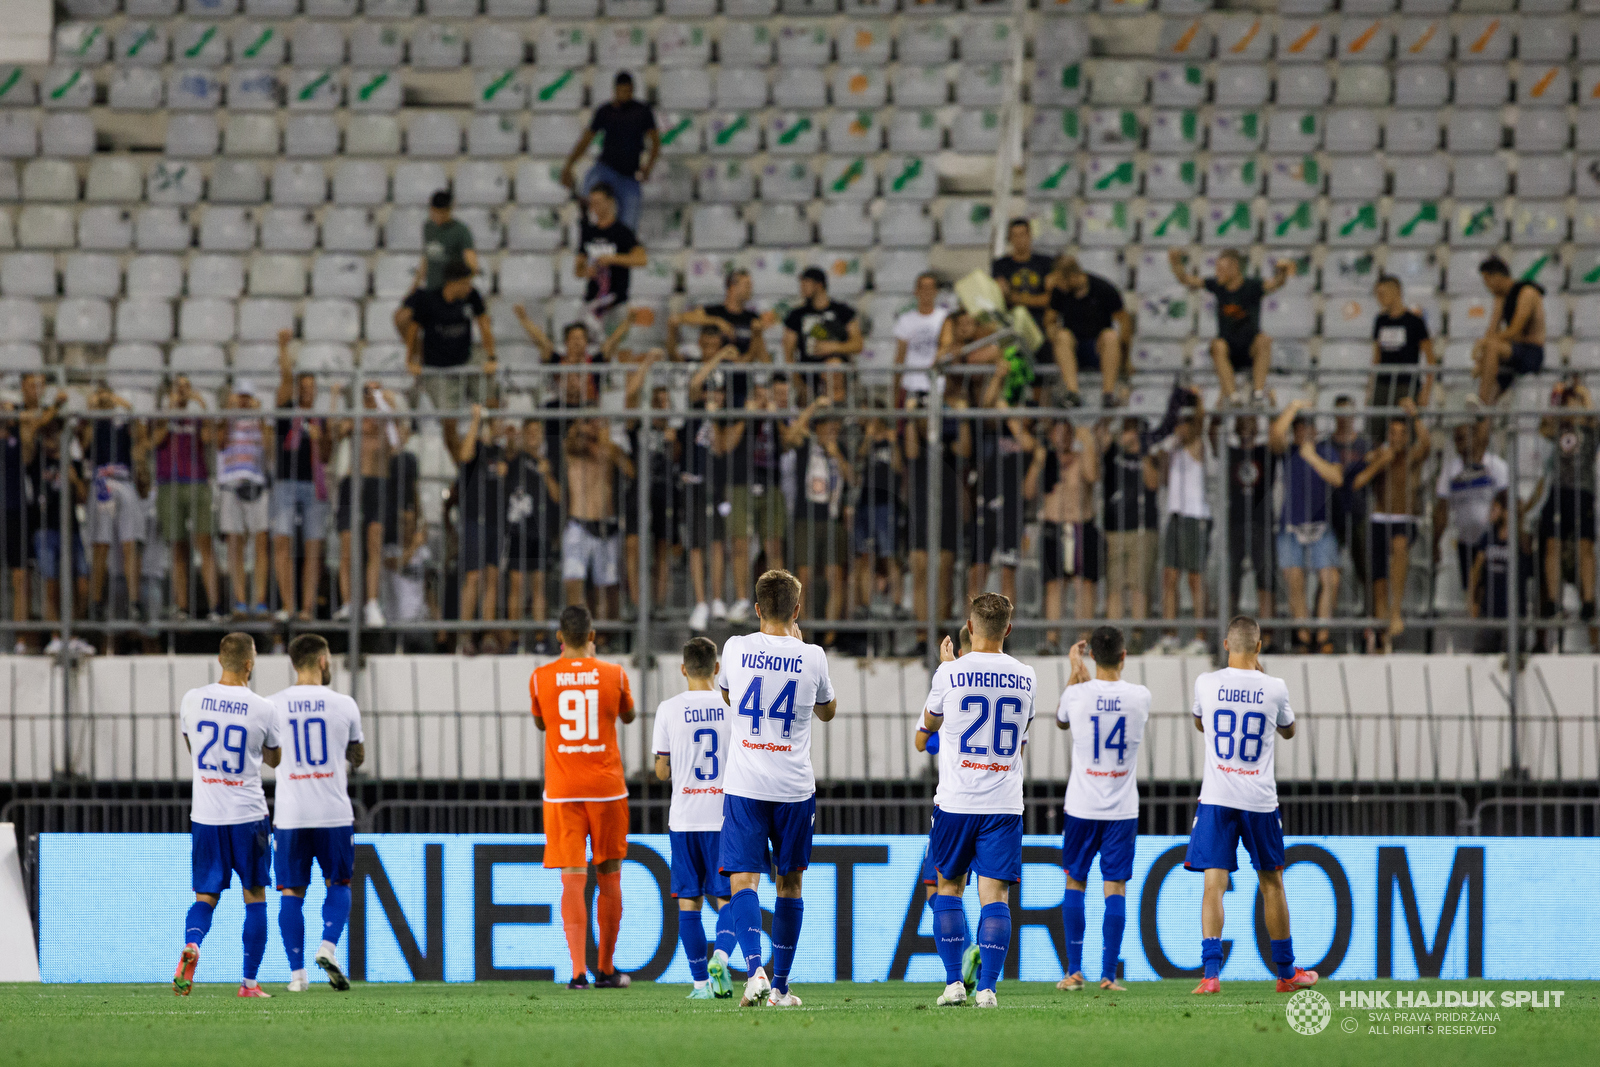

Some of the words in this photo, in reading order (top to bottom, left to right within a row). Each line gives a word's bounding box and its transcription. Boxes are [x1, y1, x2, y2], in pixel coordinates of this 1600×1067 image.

[741, 651, 803, 673] VUŠKOVIĆ
[556, 667, 599, 686] KALINIĆ
[950, 672, 1032, 691] LOVRENCSICS
[1096, 696, 1121, 712] ČUIĆ
[1218, 685, 1264, 704] ĆUBELIĆ
[201, 698, 248, 716] MLAKAR
[288, 700, 325, 713] LIVAJA
[558, 689, 599, 740] 91
[684, 706, 725, 723] ČOLINA
[738, 675, 799, 739] 44
[959, 694, 1023, 758] 26
[1213, 708, 1267, 762] 88
[197, 720, 247, 774] 29
[289, 717, 328, 767] 10
[741, 739, 792, 752] SuperSport
[1090, 715, 1127, 765] 14
[693, 728, 720, 781] 3
[289, 771, 334, 781] SuperSport
[682, 786, 723, 795] SuperSpo
